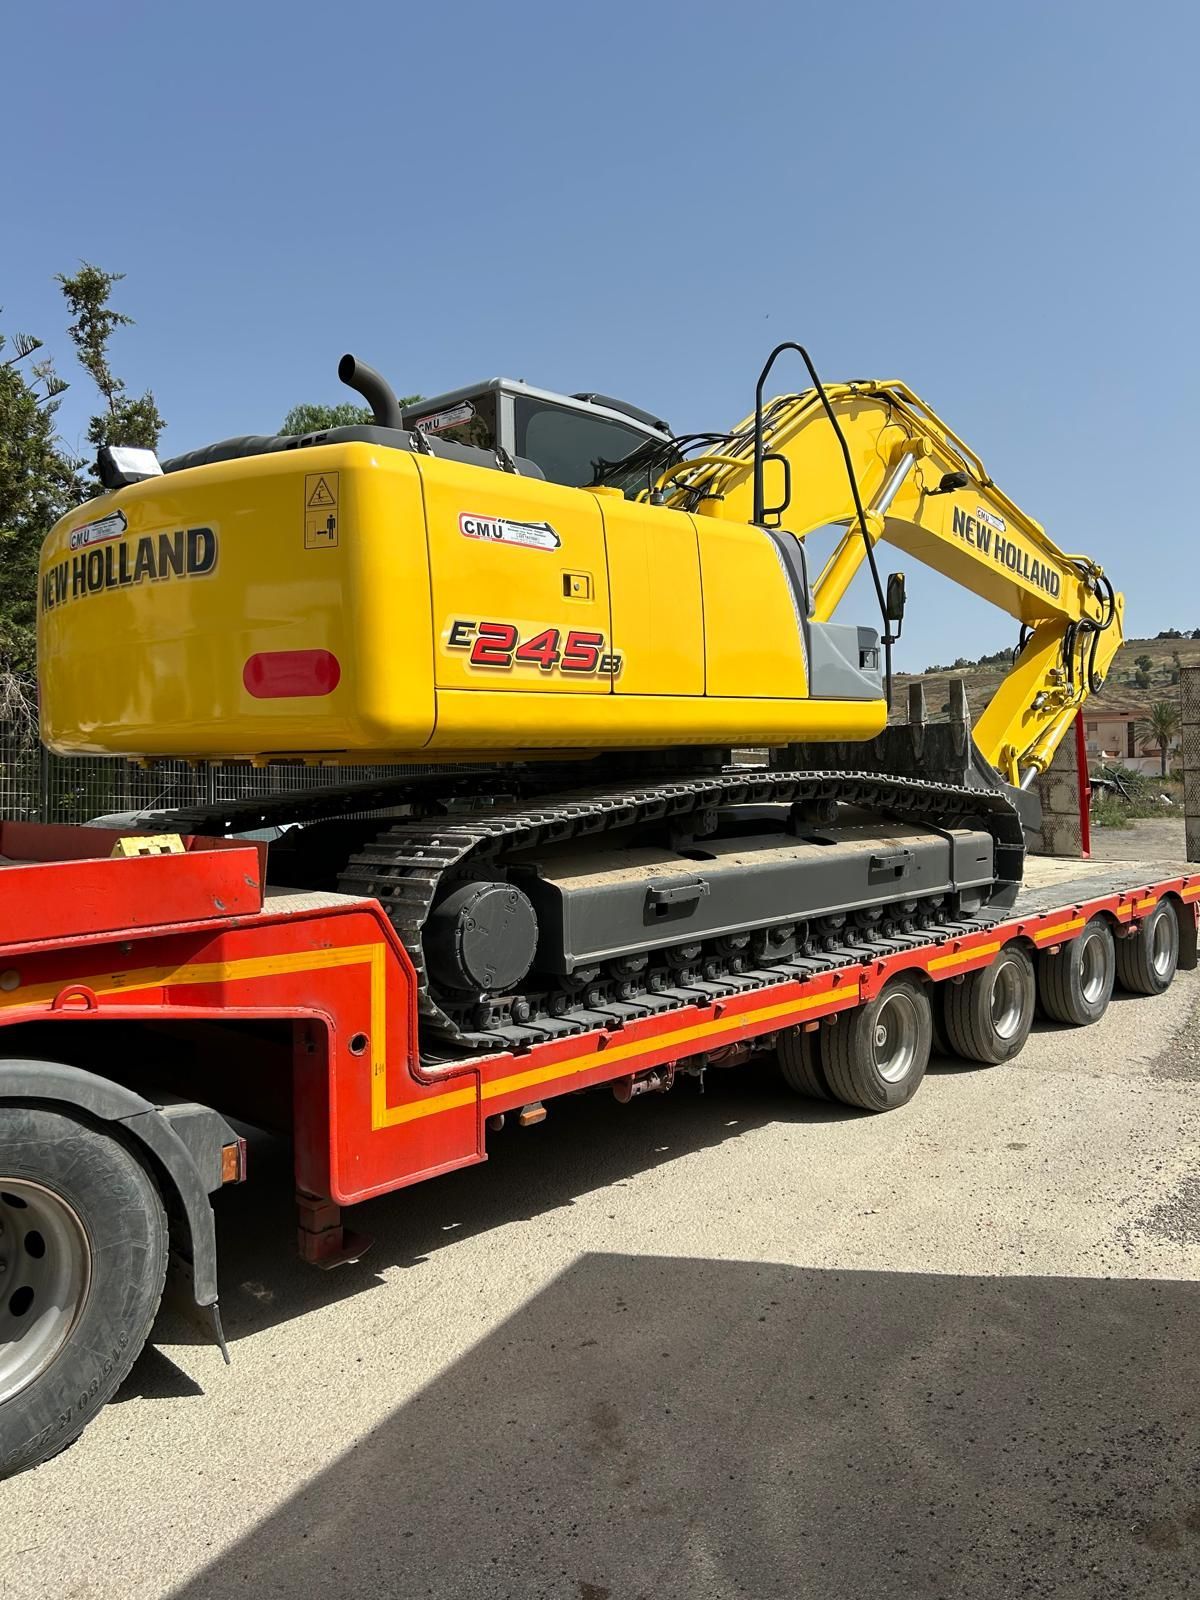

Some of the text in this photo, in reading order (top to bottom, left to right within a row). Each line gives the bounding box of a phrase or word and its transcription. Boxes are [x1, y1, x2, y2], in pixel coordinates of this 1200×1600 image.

[41, 527, 217, 616] NEW HOLLAND
[952, 506, 1060, 598] NEW HOLLAND
